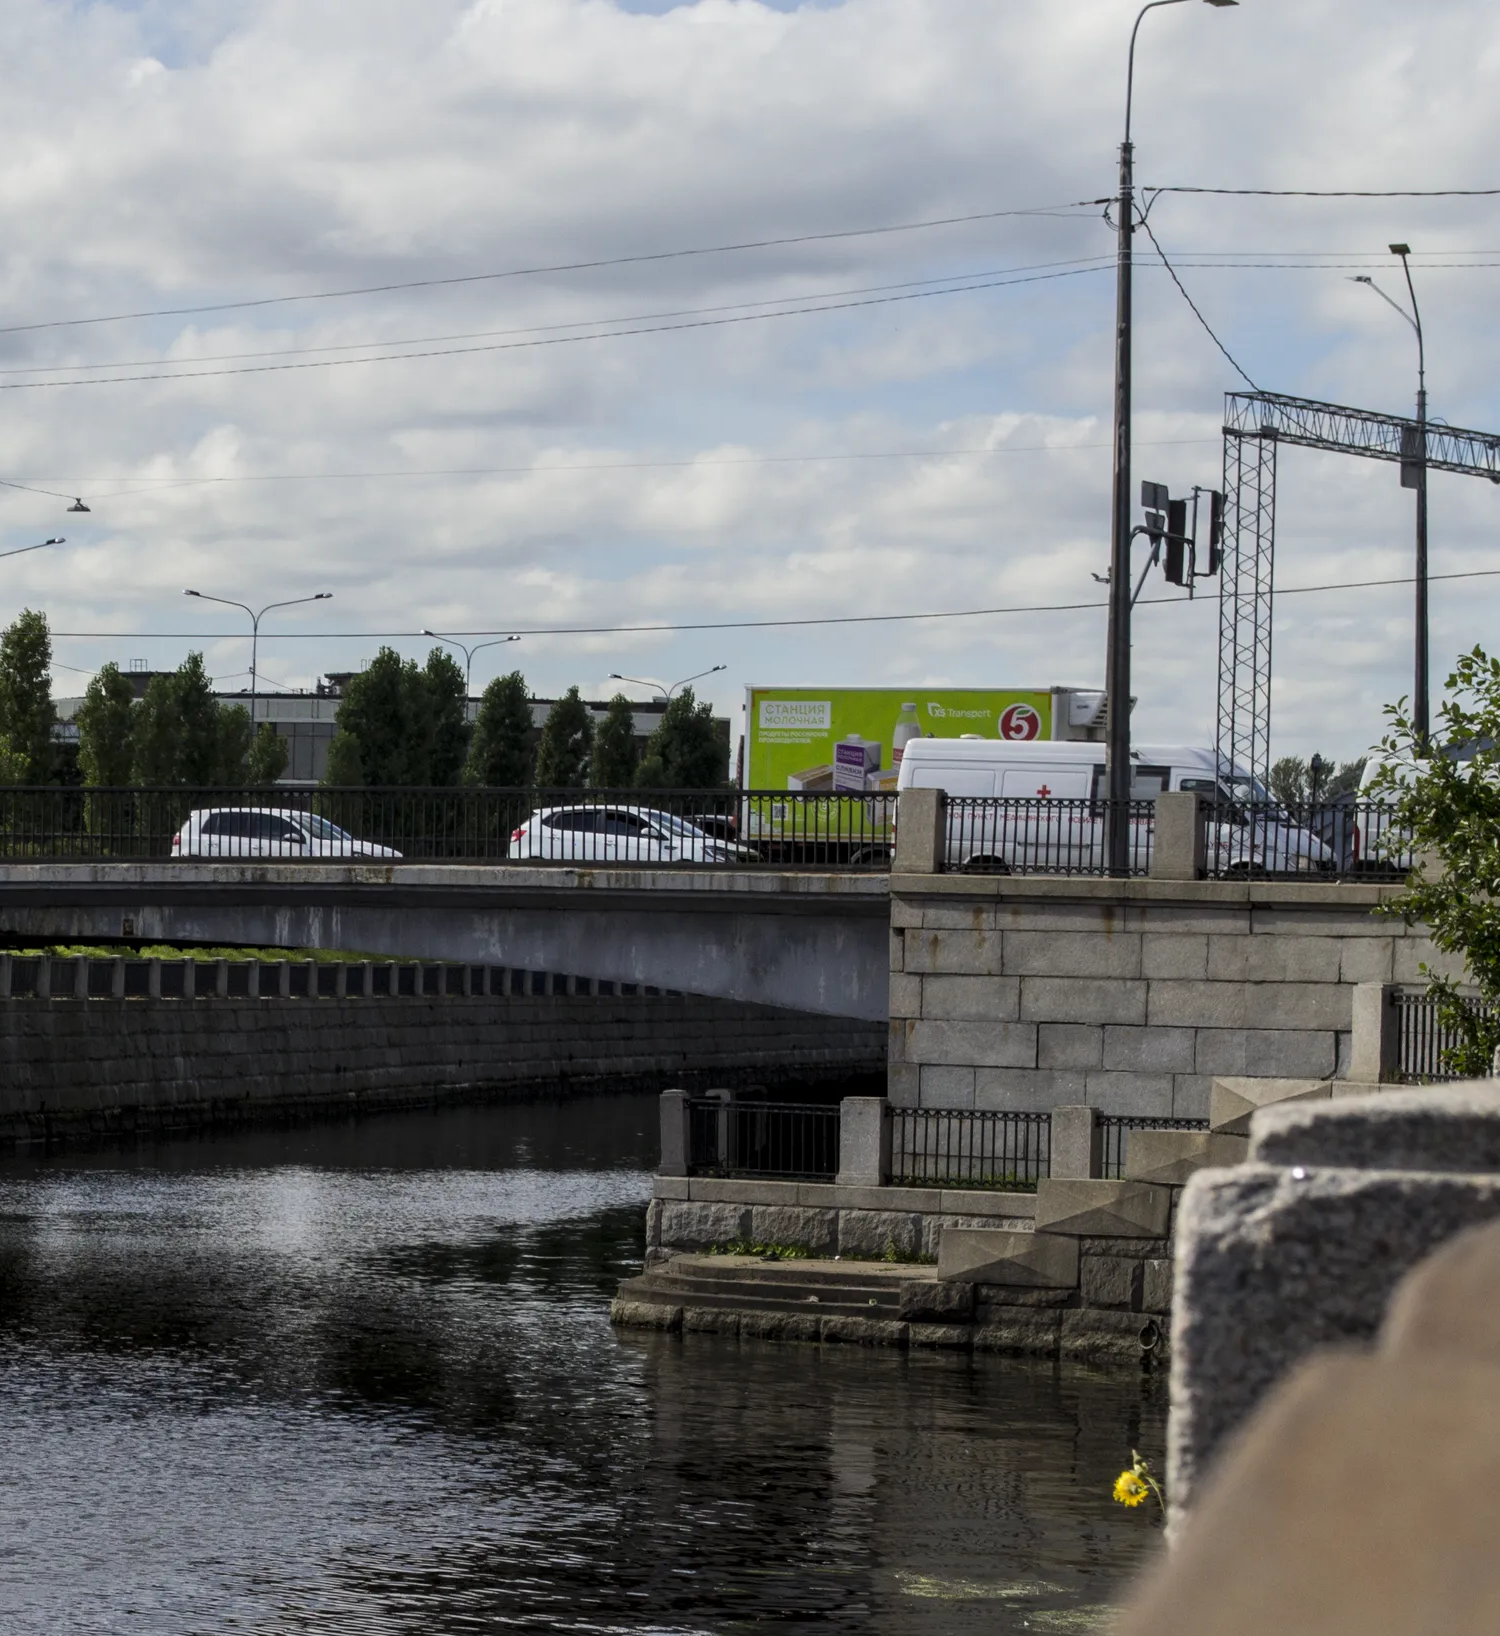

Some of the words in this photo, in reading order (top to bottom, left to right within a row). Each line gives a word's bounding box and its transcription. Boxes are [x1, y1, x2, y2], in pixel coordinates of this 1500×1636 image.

[765, 704, 825, 715] СТАНЦИЯ
[947, 708, 991, 718] Transport
[764, 716, 825, 725] МОЛОЧНАЯ
[1009, 706, 1031, 740] 5
[999, 813, 1062, 823] МЕДИЦИНКОГО
